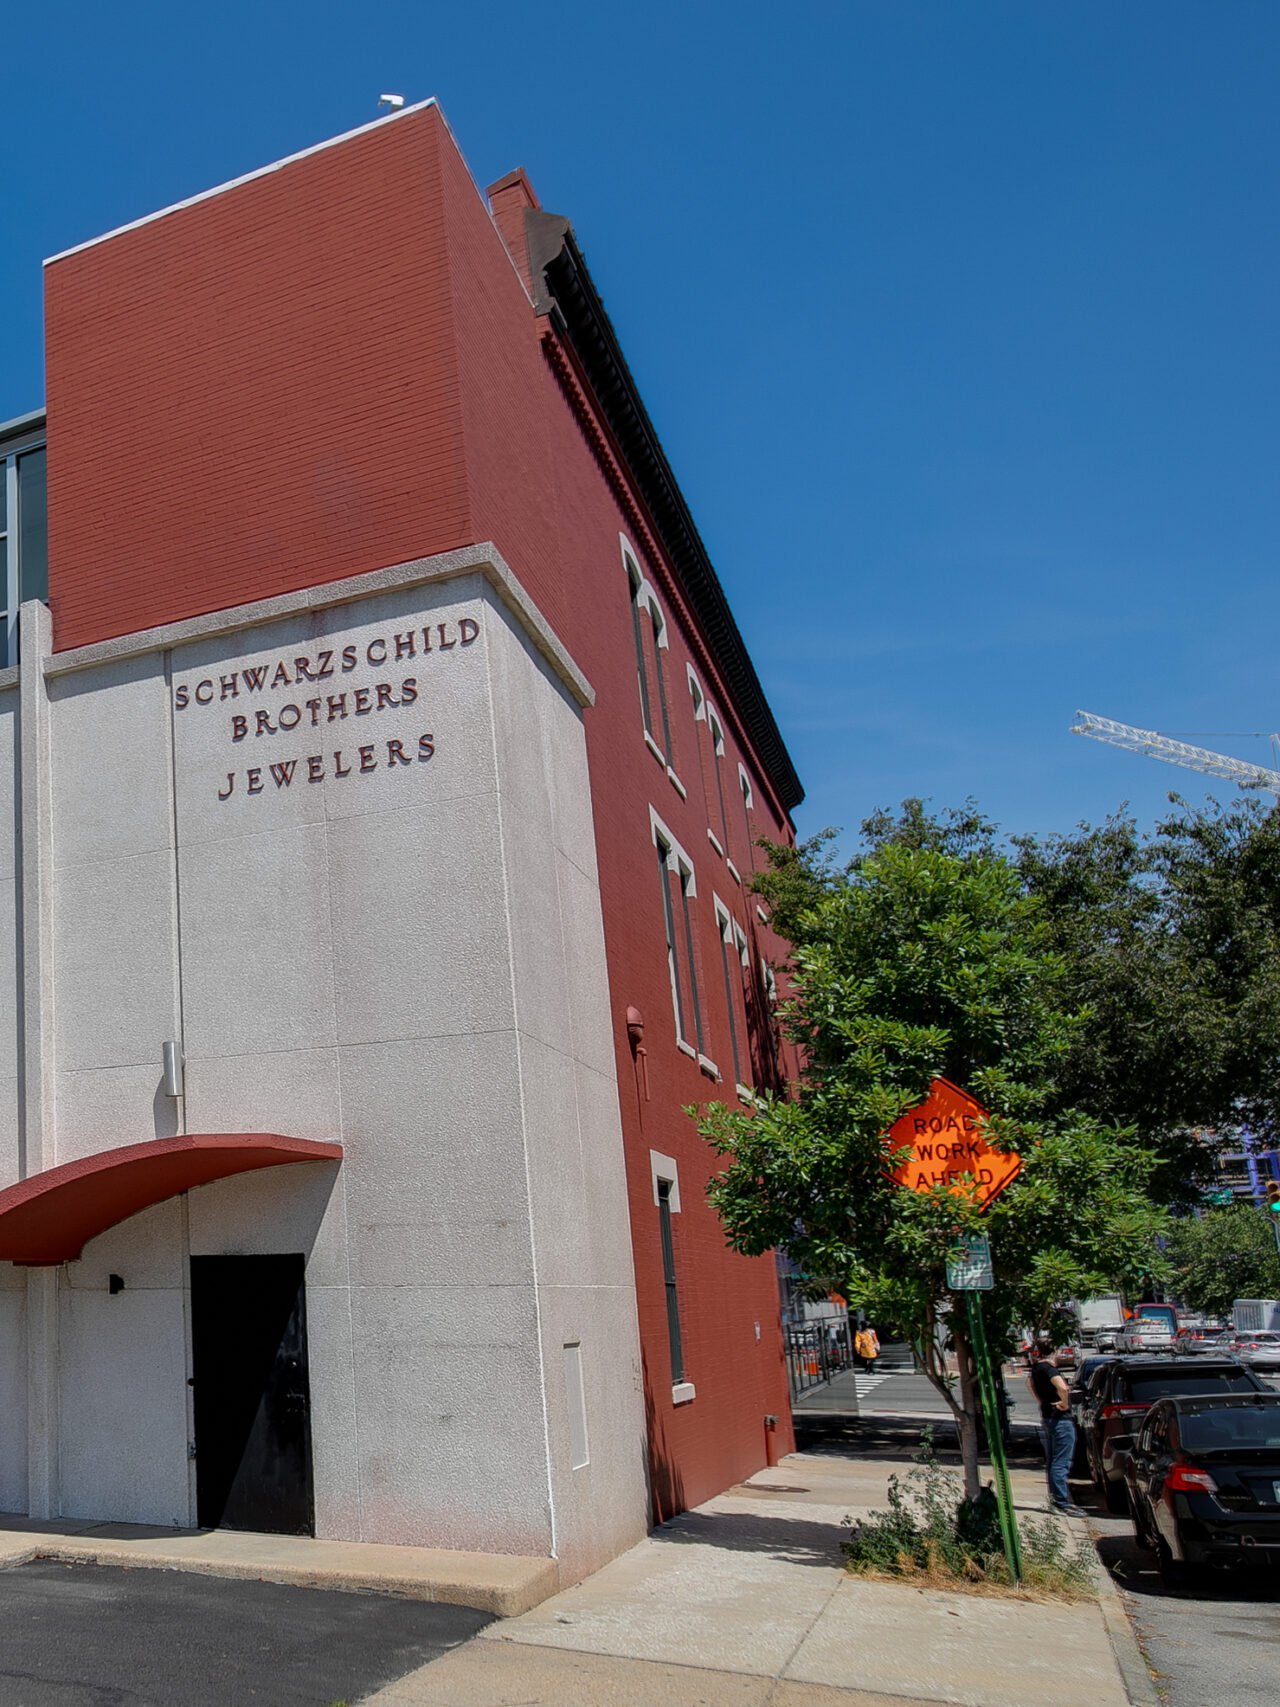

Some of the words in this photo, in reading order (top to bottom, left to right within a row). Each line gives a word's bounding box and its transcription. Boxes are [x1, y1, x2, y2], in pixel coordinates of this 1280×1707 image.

[175, 618, 480, 710] SCHWARZSCHILD
[231, 677, 418, 741] BROTHERS
[218, 733, 436, 800] JEWELERS
[913, 1115, 976, 1134] ROAD
[916, 1141, 981, 1161] WORK
